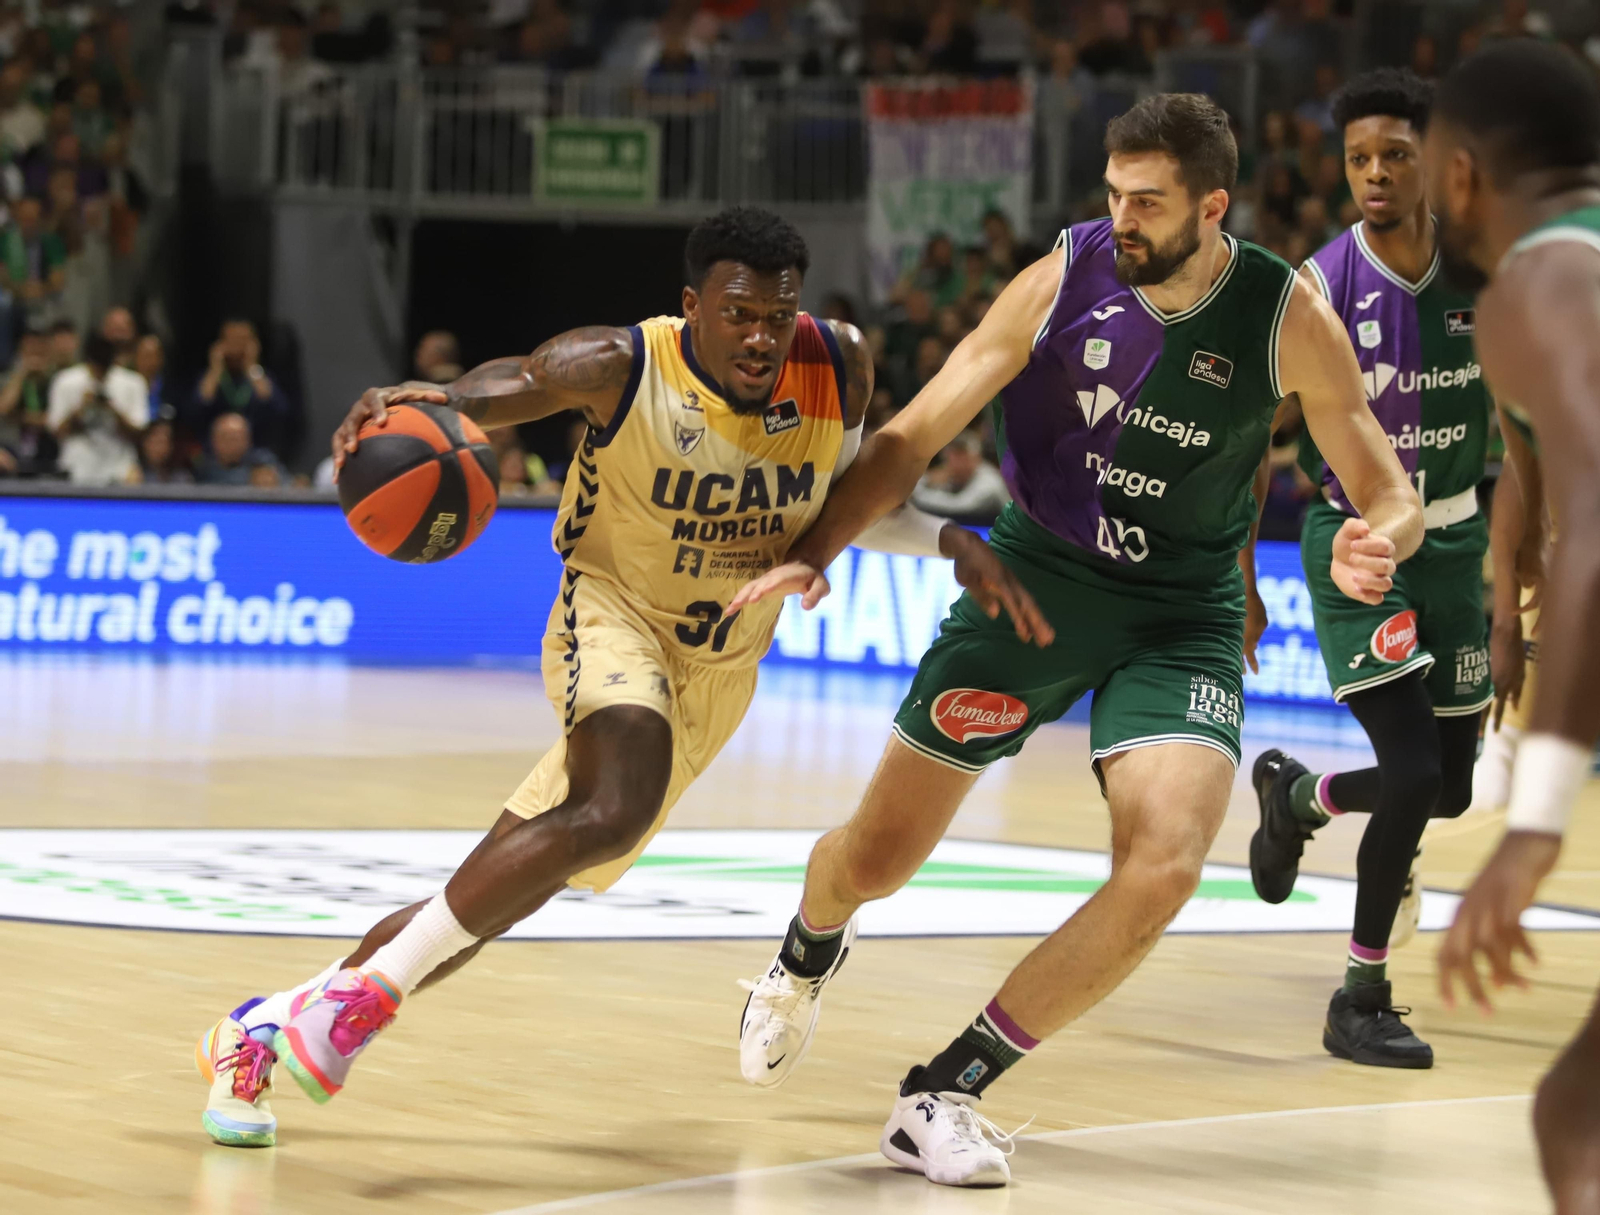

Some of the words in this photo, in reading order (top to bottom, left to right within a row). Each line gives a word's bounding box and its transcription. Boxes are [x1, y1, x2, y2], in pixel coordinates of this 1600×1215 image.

[1194, 368, 1227, 385] endesa
[1196, 360, 1212, 371] liga
[1397, 362, 1481, 394] Unicaja
[650, 461, 815, 517] UCAM
[1085, 451, 1167, 499] mlaga
[671, 513, 785, 543] MURCIA
[66, 522, 222, 583] most
[166, 580, 354, 646] choice
[1190, 674, 1219, 686] sabor
[937, 692, 1025, 725] famadesa
[1188, 691, 1239, 728] laga
[1199, 684, 1240, 713] má
